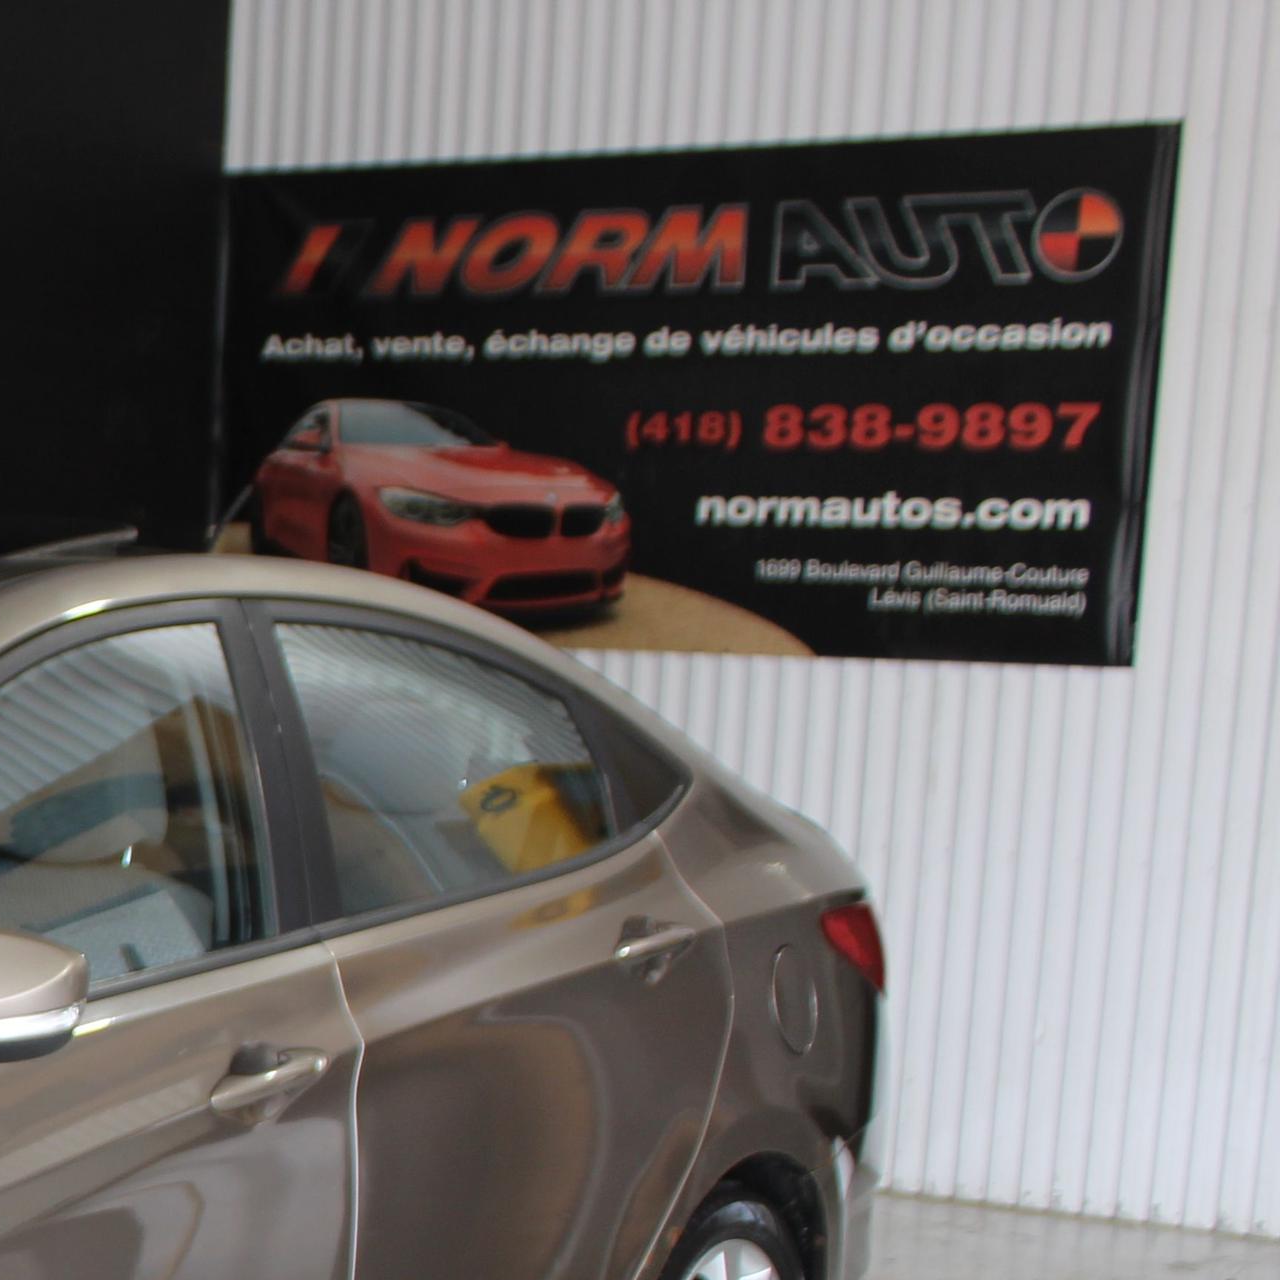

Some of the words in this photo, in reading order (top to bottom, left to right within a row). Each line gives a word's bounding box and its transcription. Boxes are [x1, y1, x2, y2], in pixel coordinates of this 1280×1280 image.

[360, 204, 749, 298] NORM
[261, 333, 364, 361] Achat,
[372, 332, 475, 360] vente,
[484, 328, 637, 361] échange
[644, 326, 692, 356] de
[700, 322, 880, 355] véhicules
[887, 316, 1114, 353] d'occasion
[626, 411, 743, 450] (418)
[762, 402, 1103, 450] 838-9897
[696, 491, 1092, 529] normautos.com
[803, 558, 900, 584] Boulevard
[901, 561, 1090, 588] Guillaume-Couture
[868, 587, 922, 611] Lévis
[924, 588, 1087, 618] (Saint-Romuald)
